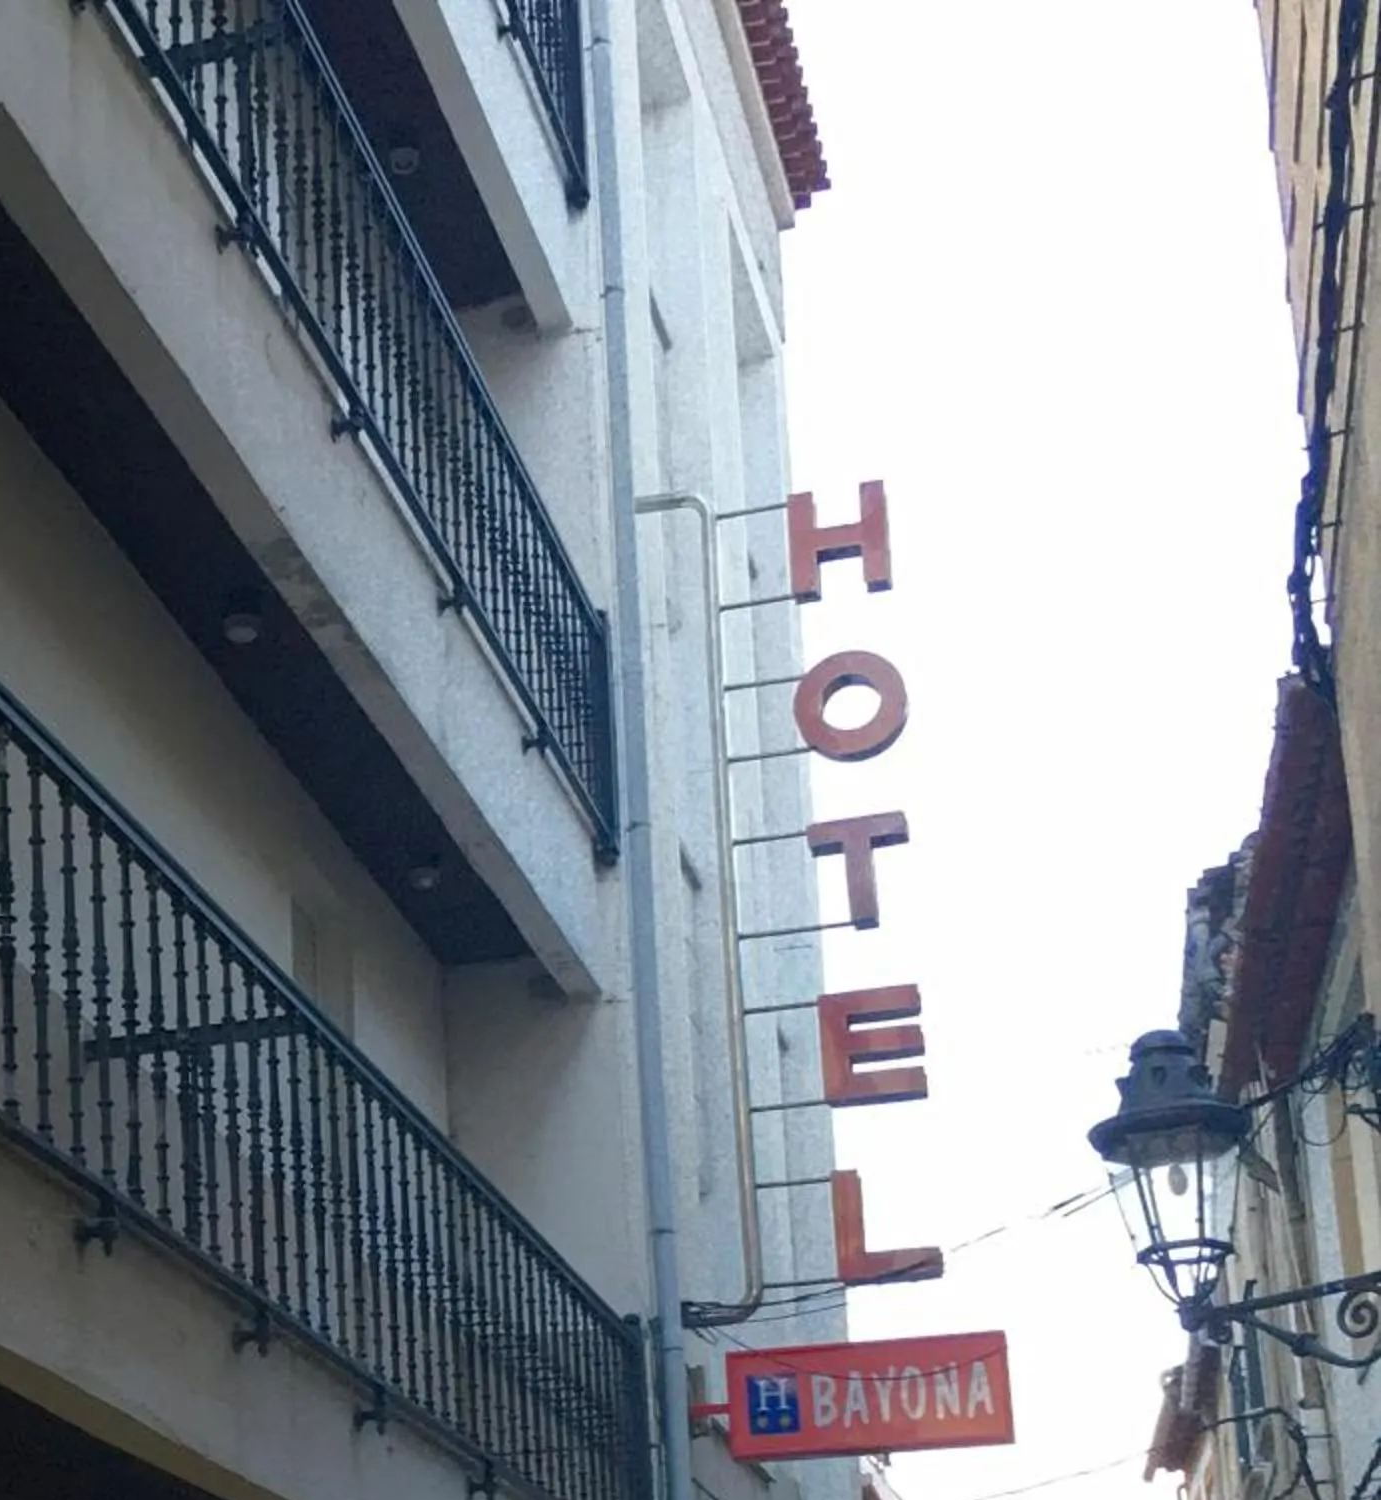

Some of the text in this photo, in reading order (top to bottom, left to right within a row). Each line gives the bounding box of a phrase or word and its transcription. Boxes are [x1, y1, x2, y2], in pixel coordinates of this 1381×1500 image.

[787, 479, 944, 1285] HOTEL
[755, 1361, 995, 1428] H BAYONA
